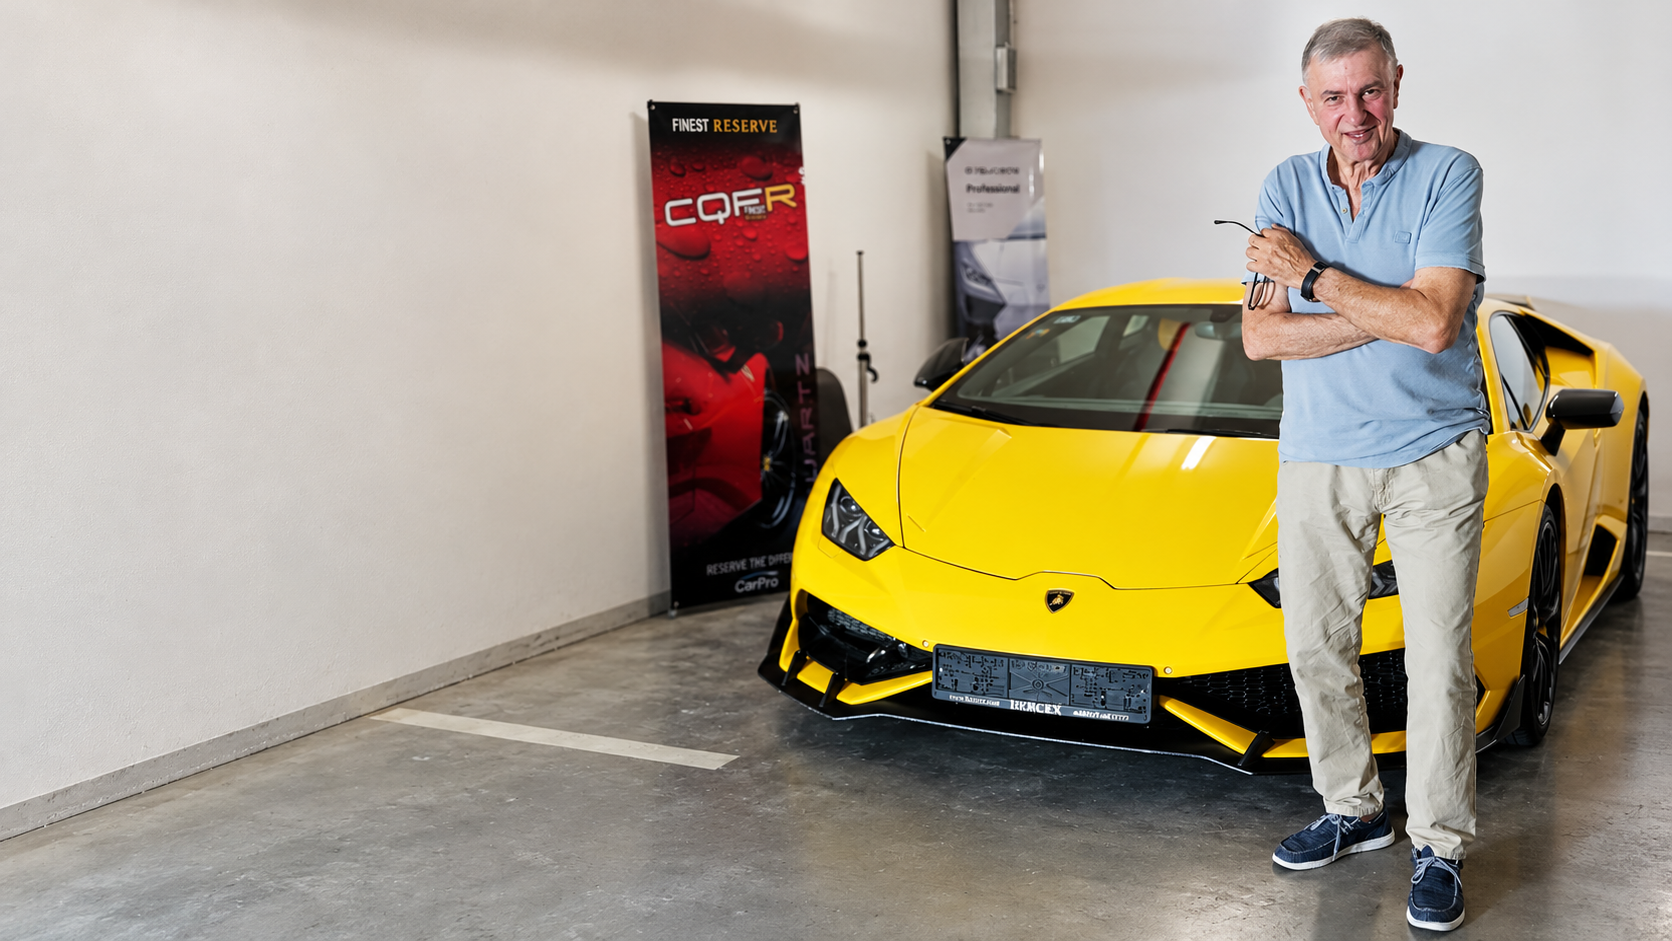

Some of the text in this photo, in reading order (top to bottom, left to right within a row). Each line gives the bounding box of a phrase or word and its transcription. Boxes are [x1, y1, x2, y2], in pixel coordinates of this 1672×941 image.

[672, 118, 777, 133] FINEST RESERVE
[966, 183, 1020, 194] Professional
[664, 183, 797, 227] CQFR
[795, 352, 818, 493] UARTZ
[706, 558, 747, 576] RESERVE
[749, 556, 766, 569] THE
[734, 576, 779, 593] CarPro
